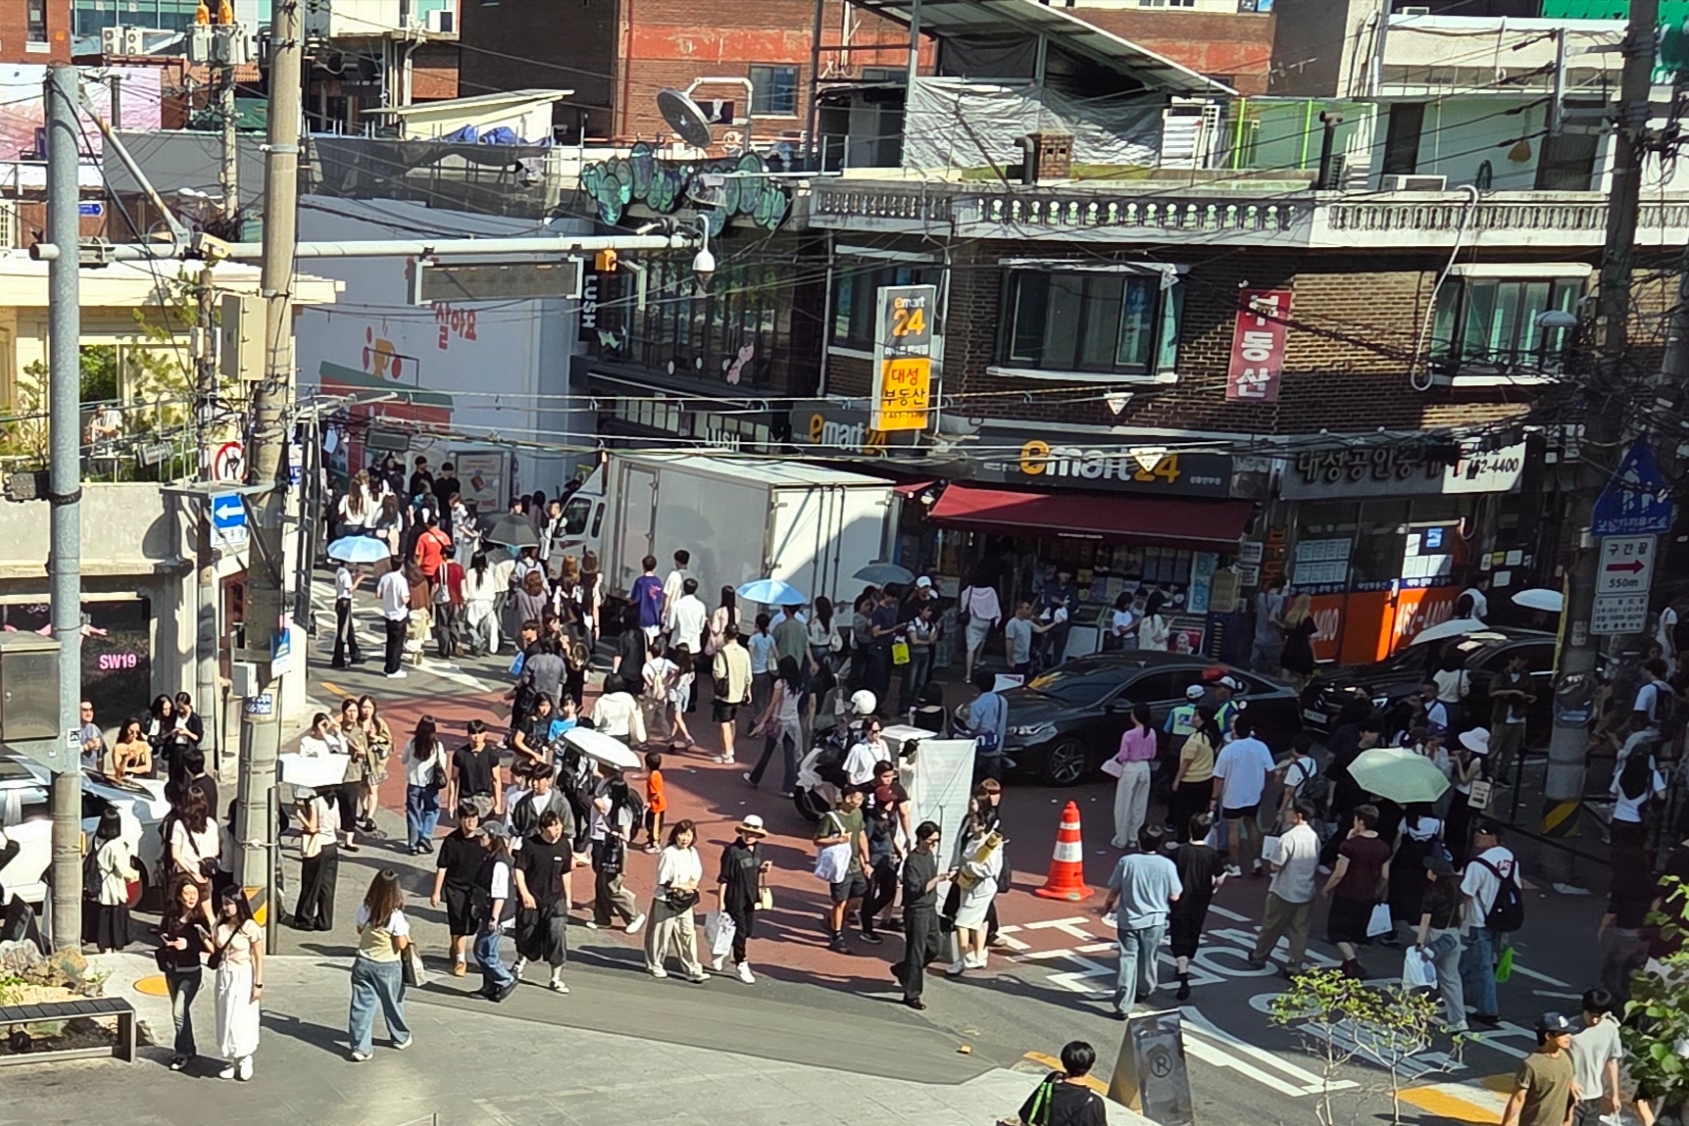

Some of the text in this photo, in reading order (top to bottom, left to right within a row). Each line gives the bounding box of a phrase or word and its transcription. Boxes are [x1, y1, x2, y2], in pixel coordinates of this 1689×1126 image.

[582, 274, 598, 329] LUSH
[894, 296, 925, 309] emart
[892, 308, 926, 337] 24
[1236, 294, 1280, 398] 부동산
[891, 367, 919, 386] 대성
[883, 387, 926, 407] 부동산
[705, 427, 741, 452] LUSH
[1608, 578, 1639, 589] 550m
[99, 653, 137, 670] SW19
